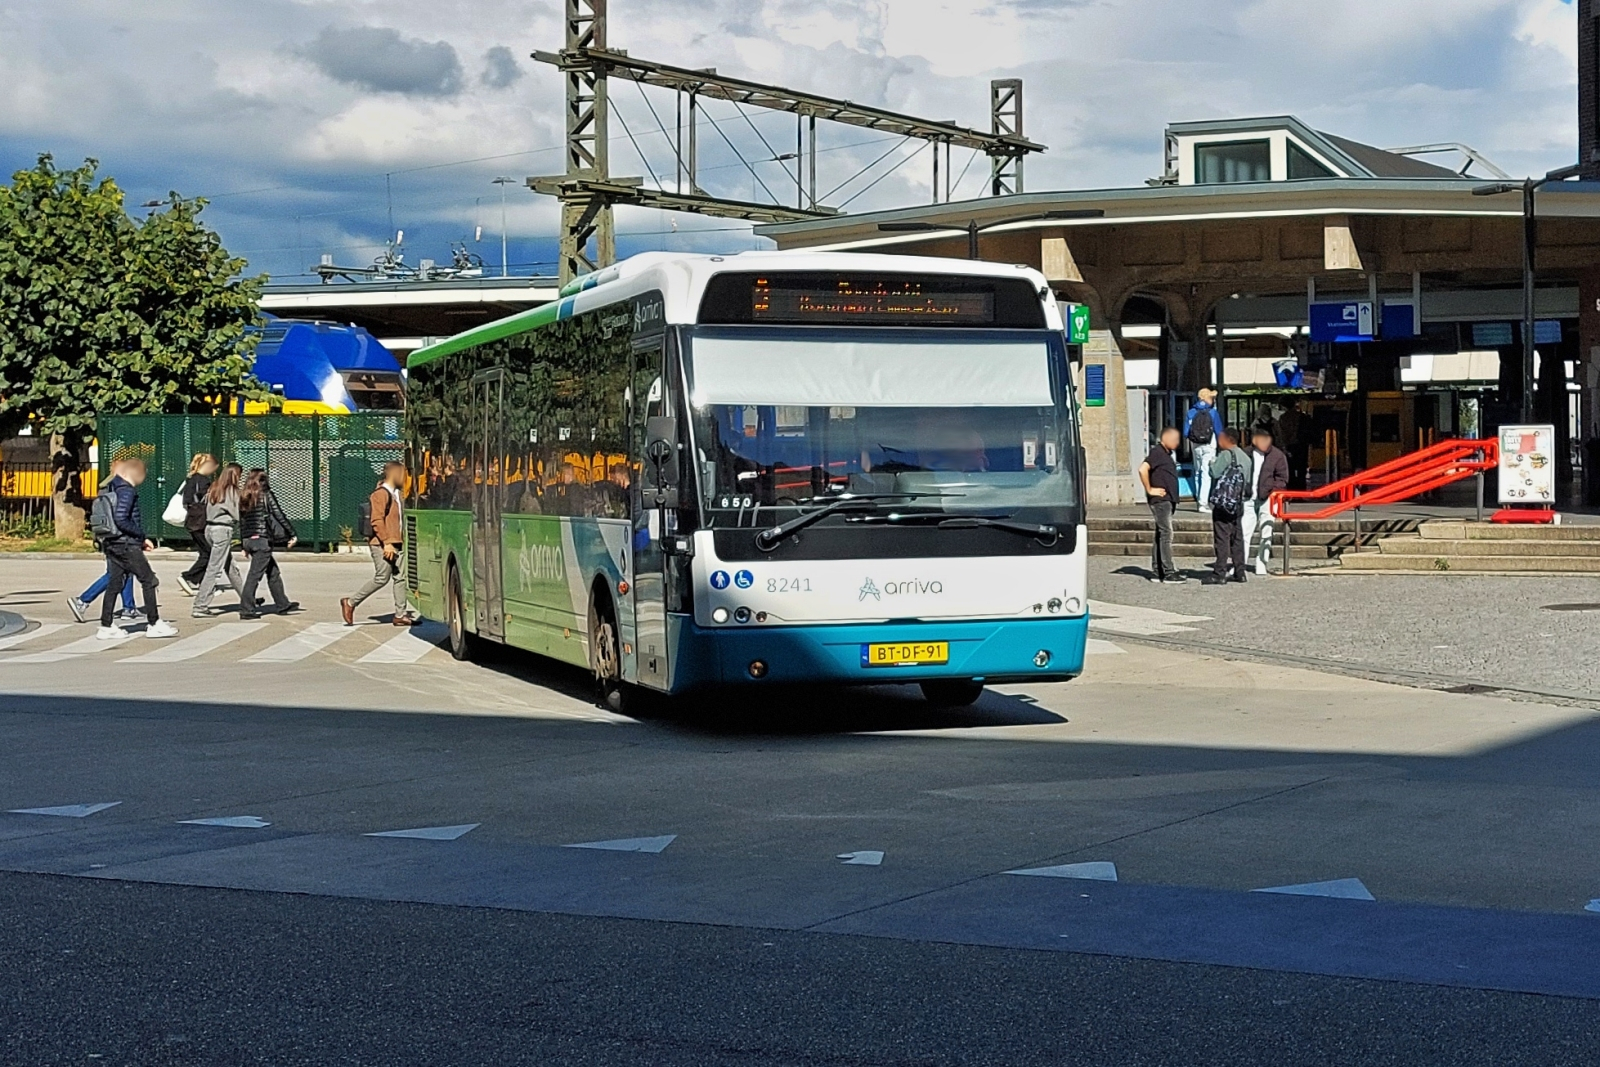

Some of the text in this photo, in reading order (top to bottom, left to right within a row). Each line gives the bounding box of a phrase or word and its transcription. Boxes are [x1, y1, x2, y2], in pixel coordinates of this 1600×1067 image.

[721, 497, 751, 508] 650
[530, 535, 563, 581] arriva
[766, 577, 813, 593] 8241
[884, 578, 943, 595] arriva
[878, 645, 941, 660] BT-DF-91
